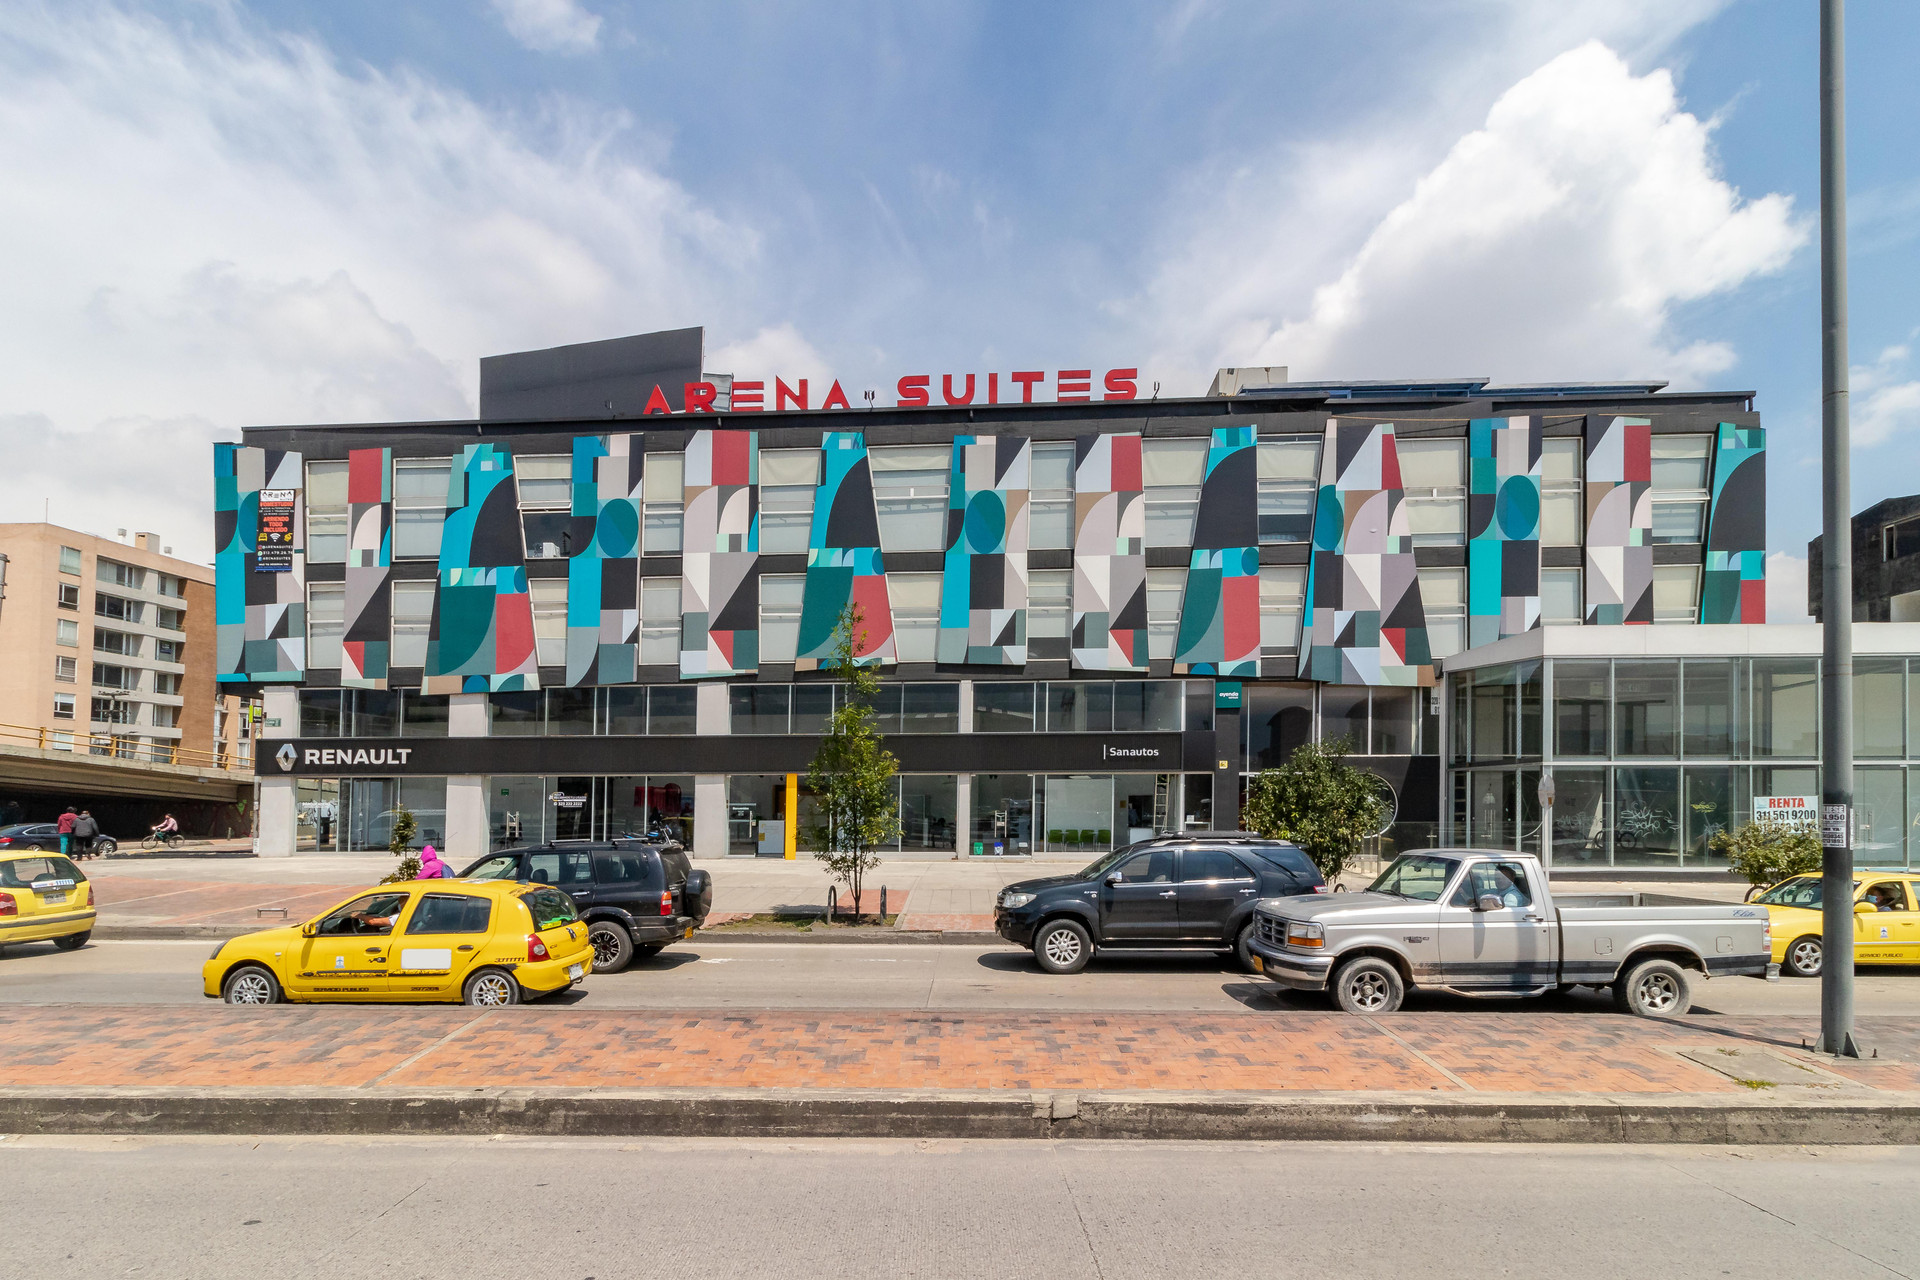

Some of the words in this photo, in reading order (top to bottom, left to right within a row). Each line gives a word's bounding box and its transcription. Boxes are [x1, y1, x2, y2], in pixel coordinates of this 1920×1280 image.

[643, 376, 851, 415] ARENA
[897, 368, 1138, 407] SUITES
[304, 748, 412, 765] RENAULT
[1109, 747, 1160, 757] Sanautos
[1769, 798, 1805, 808] RENTA
[1756, 810, 1771, 820] 311
[1773, 810, 1789, 820] 561
[1792, 810, 1816, 820] 9200
